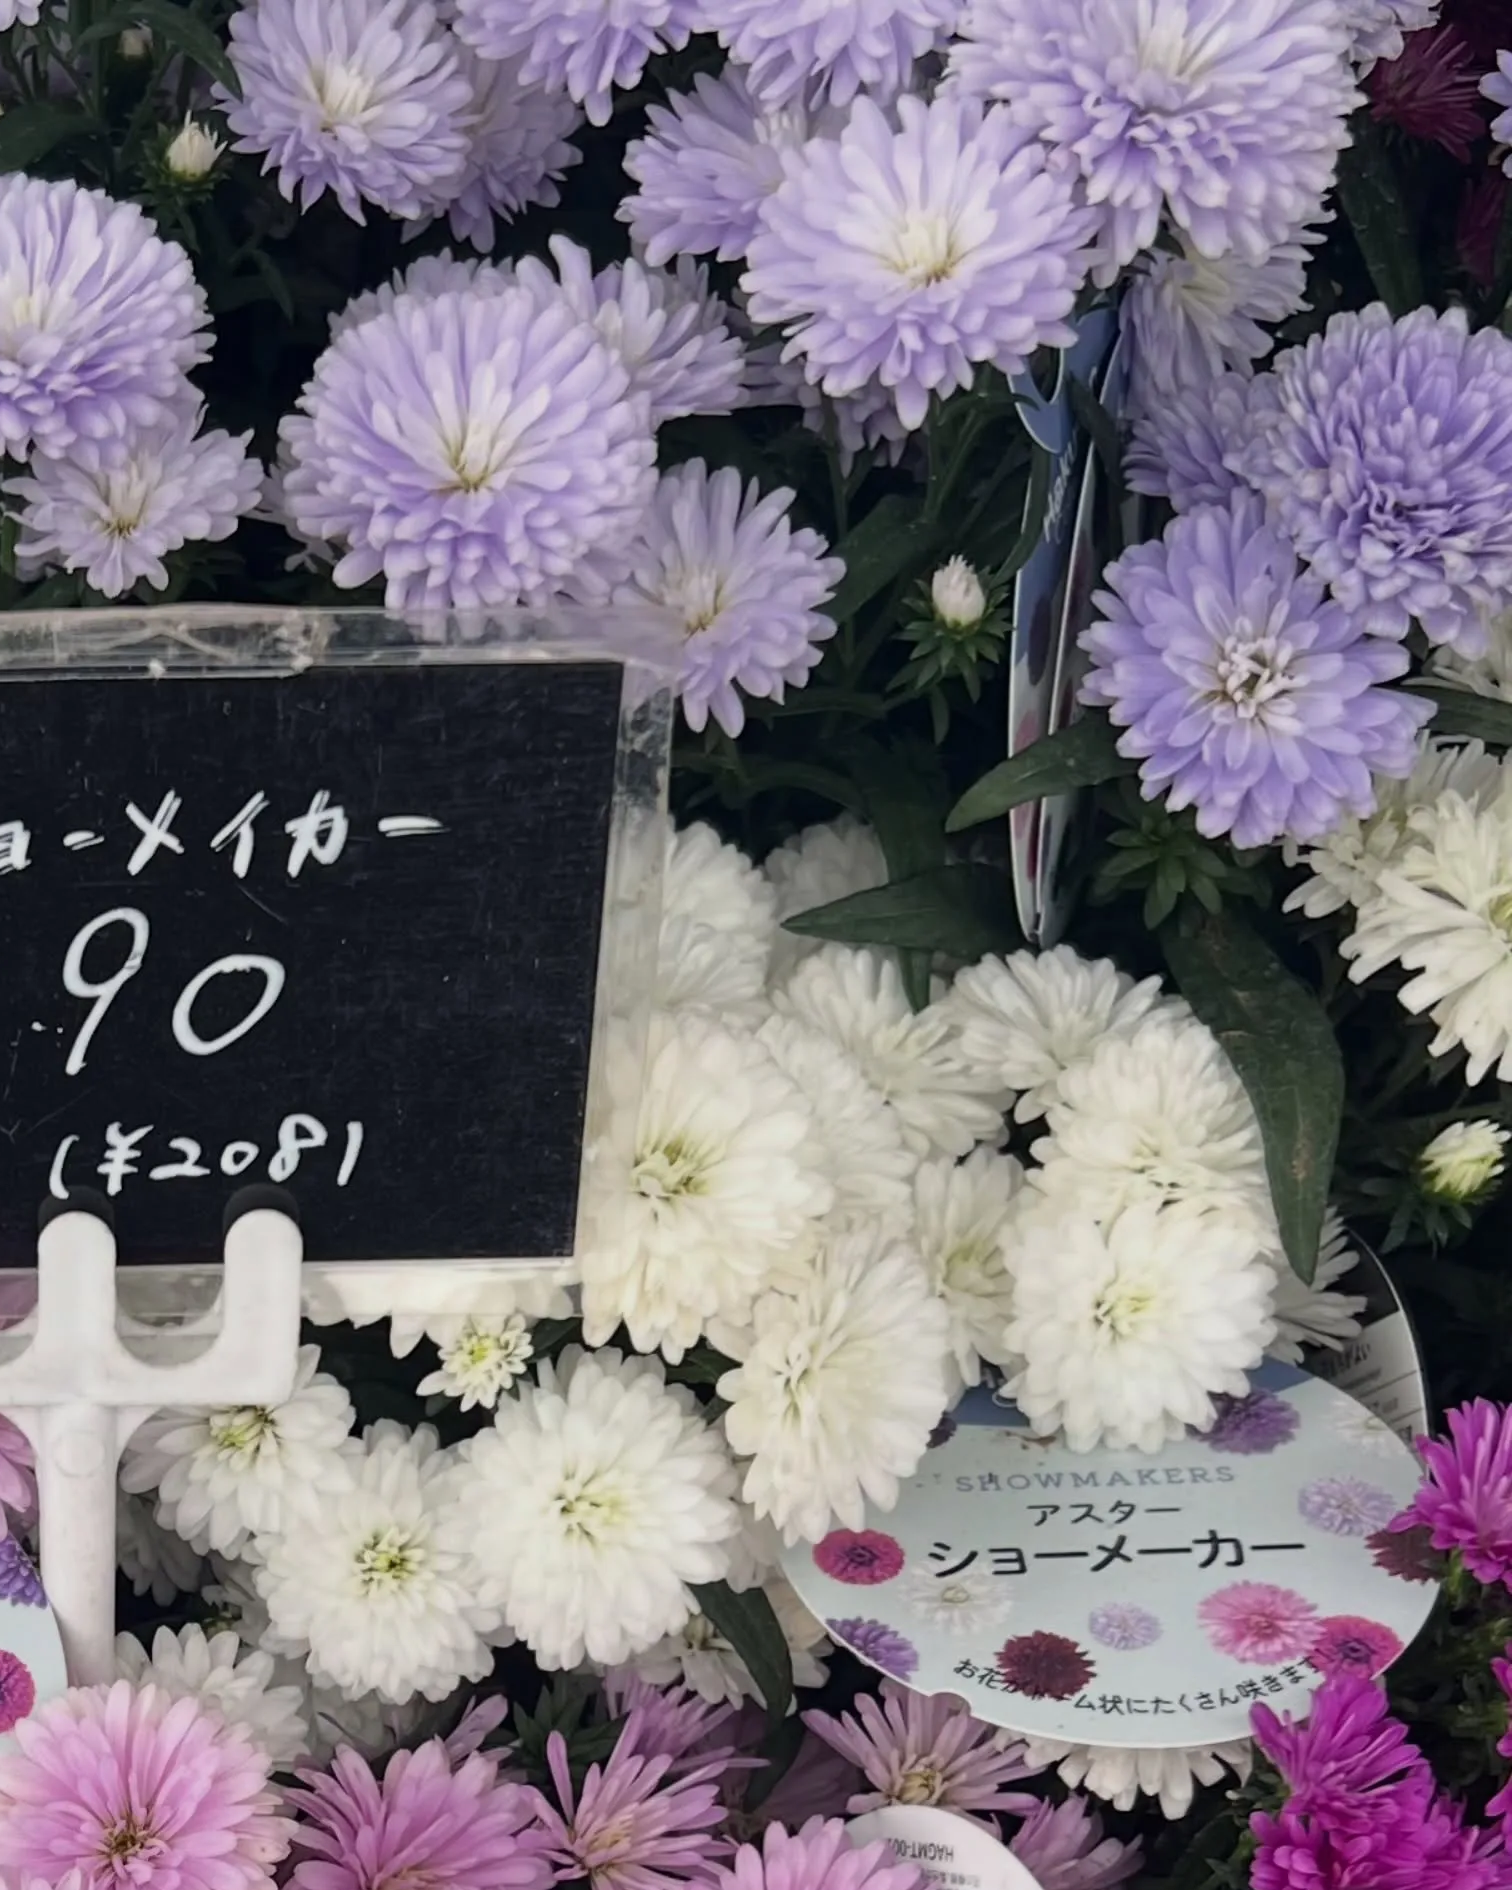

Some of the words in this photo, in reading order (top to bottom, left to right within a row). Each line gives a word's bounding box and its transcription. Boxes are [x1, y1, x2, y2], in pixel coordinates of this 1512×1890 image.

[955, 1465, 1235, 1493] SHOWMAKERS
[1026, 1500, 1182, 1527] アスター
[926, 1529, 1306, 1578] ショーメーカー
[887, 1838, 954, 1863] HAGMT-00
